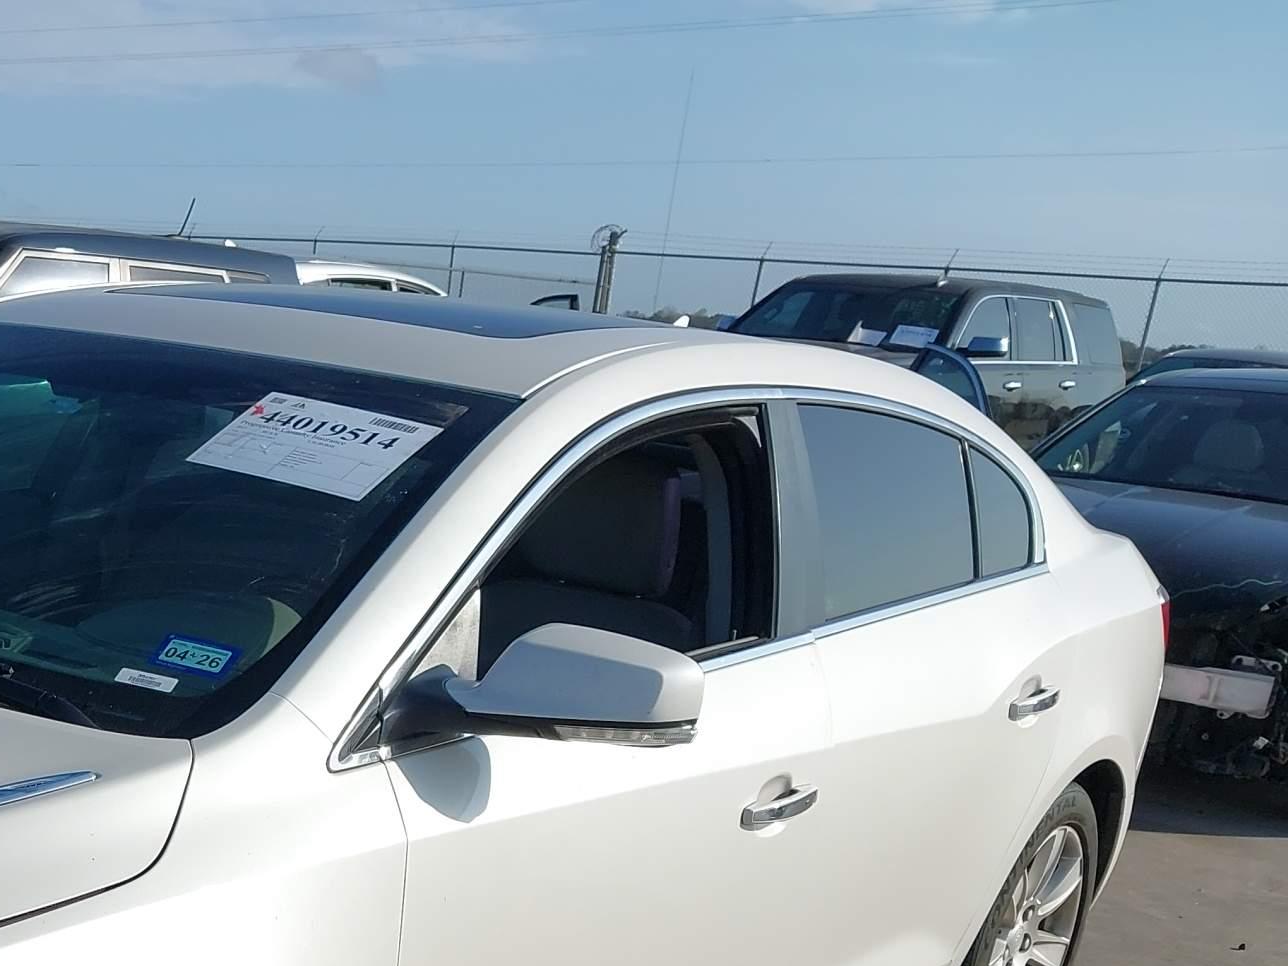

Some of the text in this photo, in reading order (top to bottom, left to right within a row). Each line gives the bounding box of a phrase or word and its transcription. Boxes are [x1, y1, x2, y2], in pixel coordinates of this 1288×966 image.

[259, 411, 402, 450] 44019514
[164, 647, 189, 661] 04
[195, 654, 222, 668] 26
